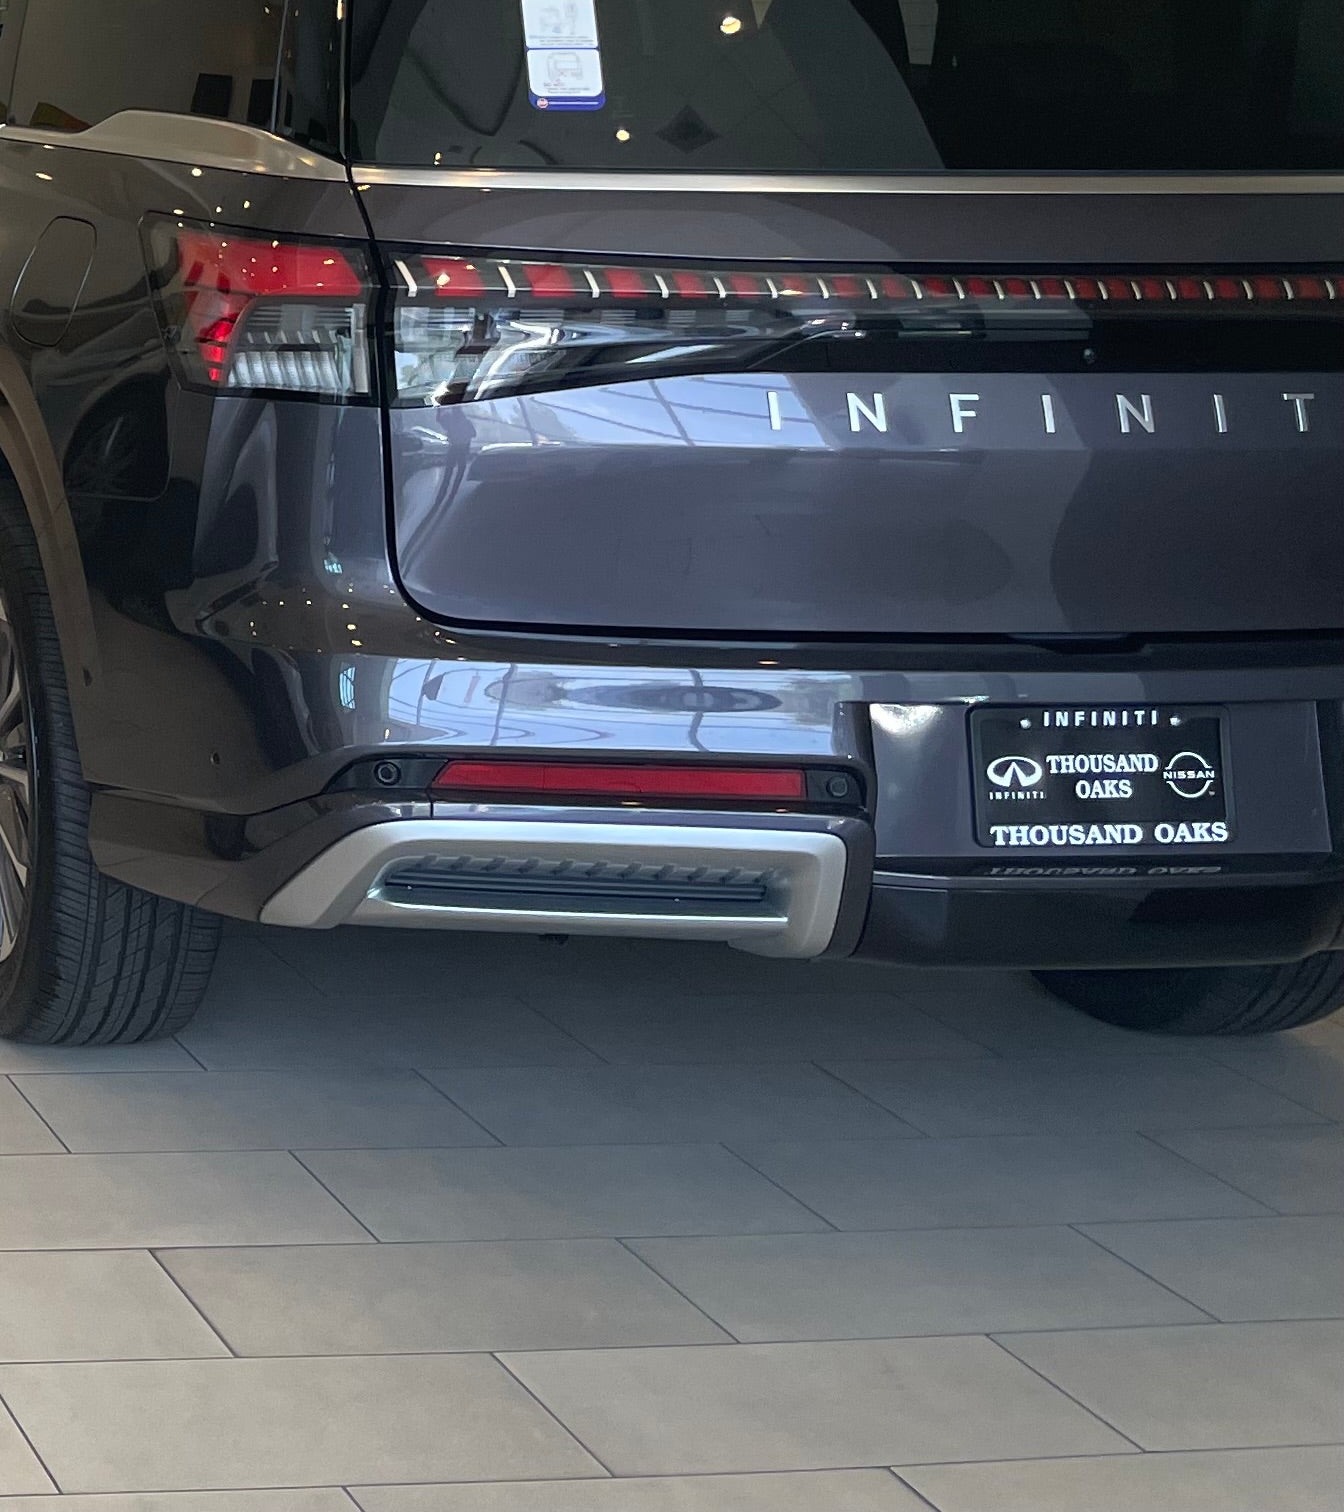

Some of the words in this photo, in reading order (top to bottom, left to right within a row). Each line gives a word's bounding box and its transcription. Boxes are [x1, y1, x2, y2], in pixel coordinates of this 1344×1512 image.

[1043, 710, 1159, 727] INFINITI
[1046, 753, 1159, 774] THOUSAND
[1162, 770, 1215, 780] NISSAN
[989, 790, 1044, 800] INFINITI
[1075, 779, 1133, 799] OAKS
[989, 824, 1144, 846] THOUSAND
[1154, 822, 1229, 843] OAKS
